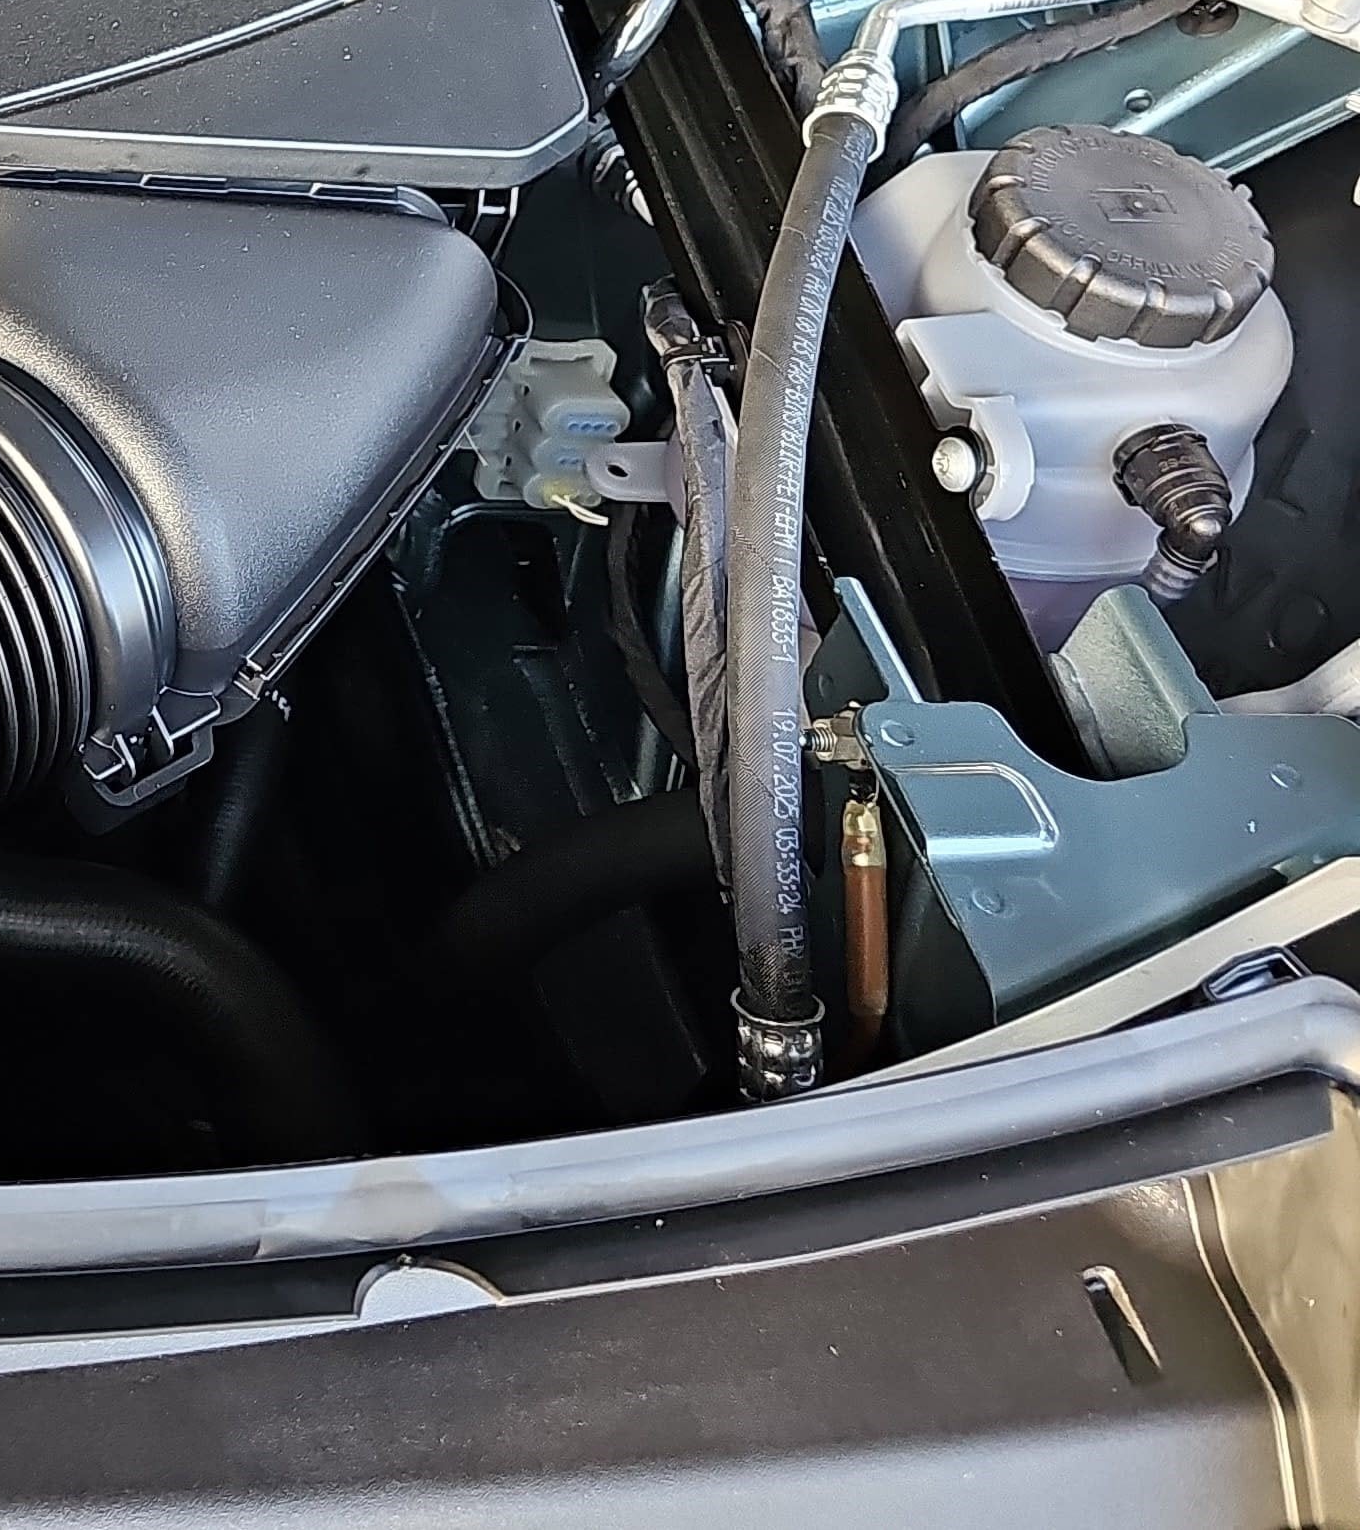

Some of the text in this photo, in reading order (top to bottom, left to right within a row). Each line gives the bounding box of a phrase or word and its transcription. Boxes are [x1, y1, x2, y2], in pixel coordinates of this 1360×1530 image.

[769, 575, 798, 663] BA1833-1
[769, 707, 800, 820] 19.07.2025
[773, 826, 803, 915] 03:33:24
